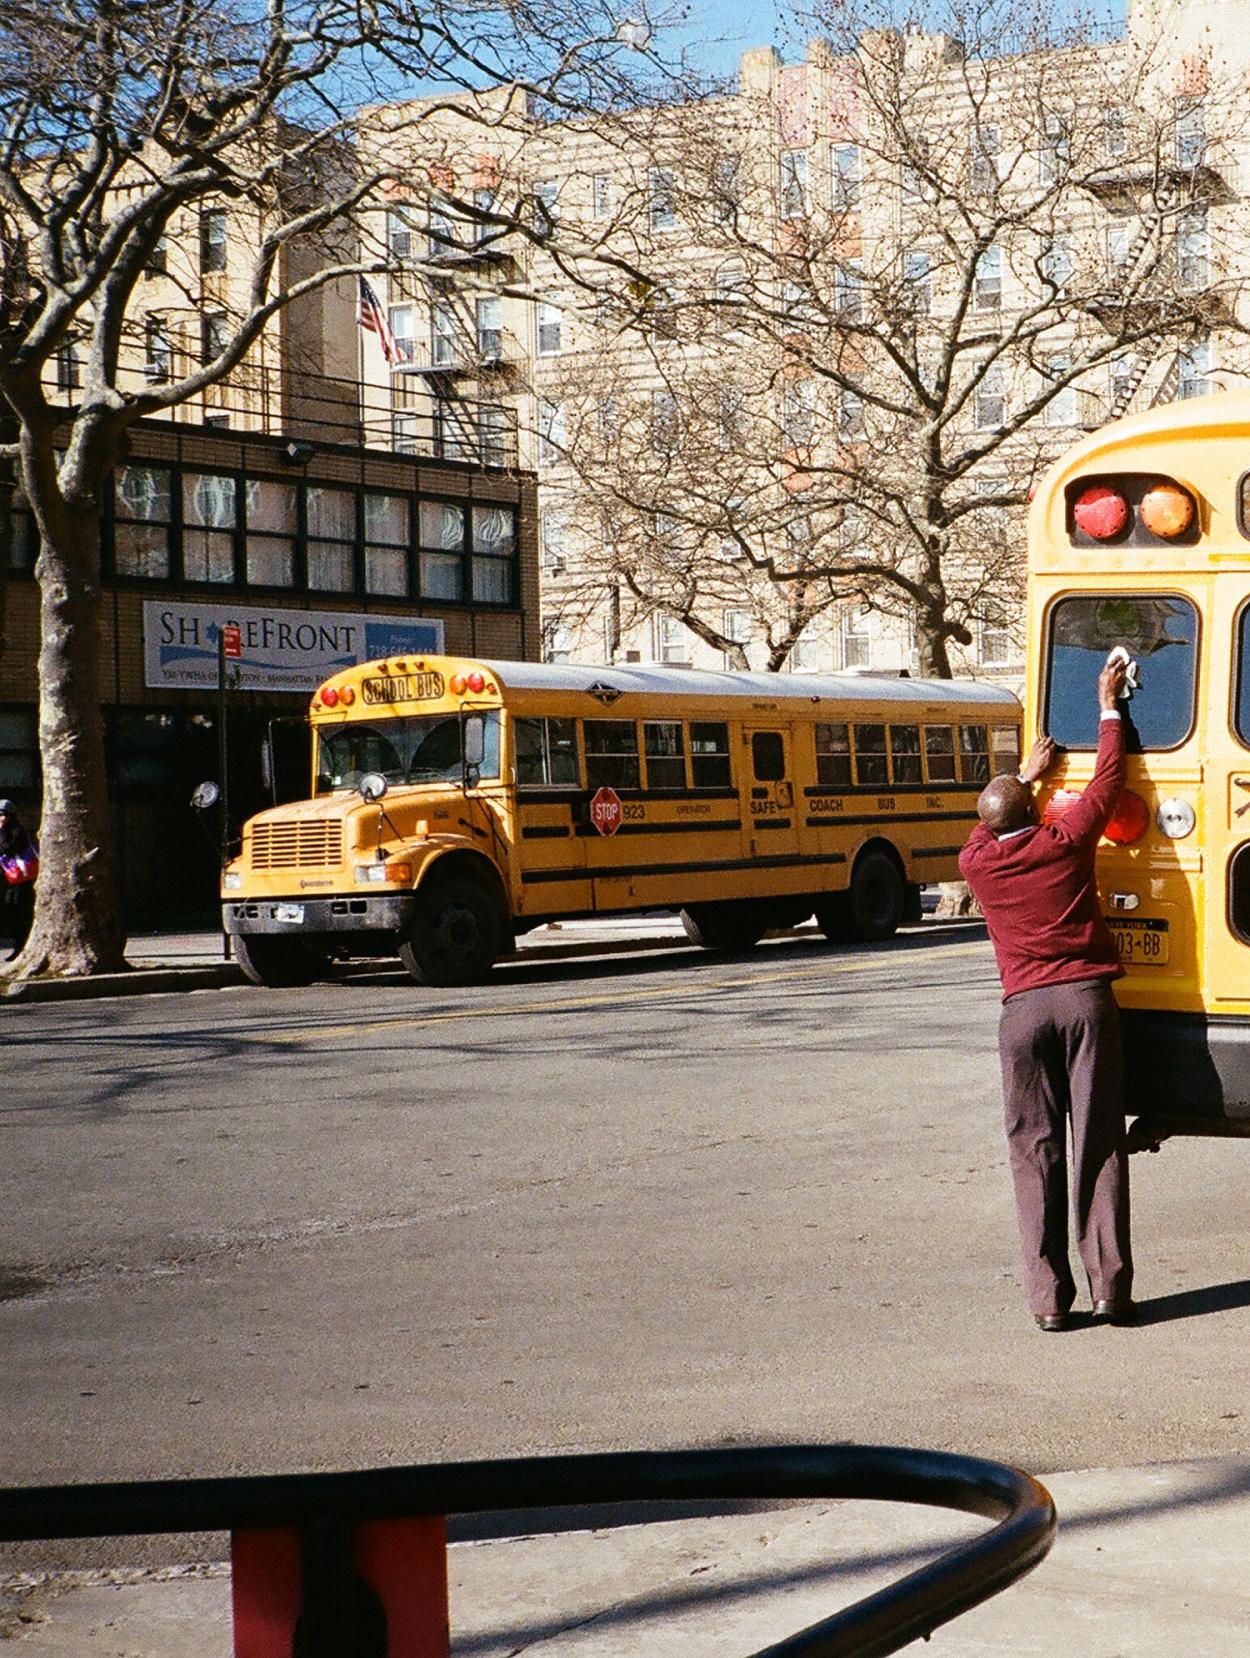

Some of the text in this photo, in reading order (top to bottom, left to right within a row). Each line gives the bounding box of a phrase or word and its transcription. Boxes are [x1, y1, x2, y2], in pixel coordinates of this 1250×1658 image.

[364, 673, 441, 703] SCHOOL BUS
[595, 803, 619, 821] STOP
[623, 805, 646, 819] 923
[750, 801, 776, 815] SAFE
[809, 799, 843, 812] COACH
[877, 797, 896, 810] BUS
